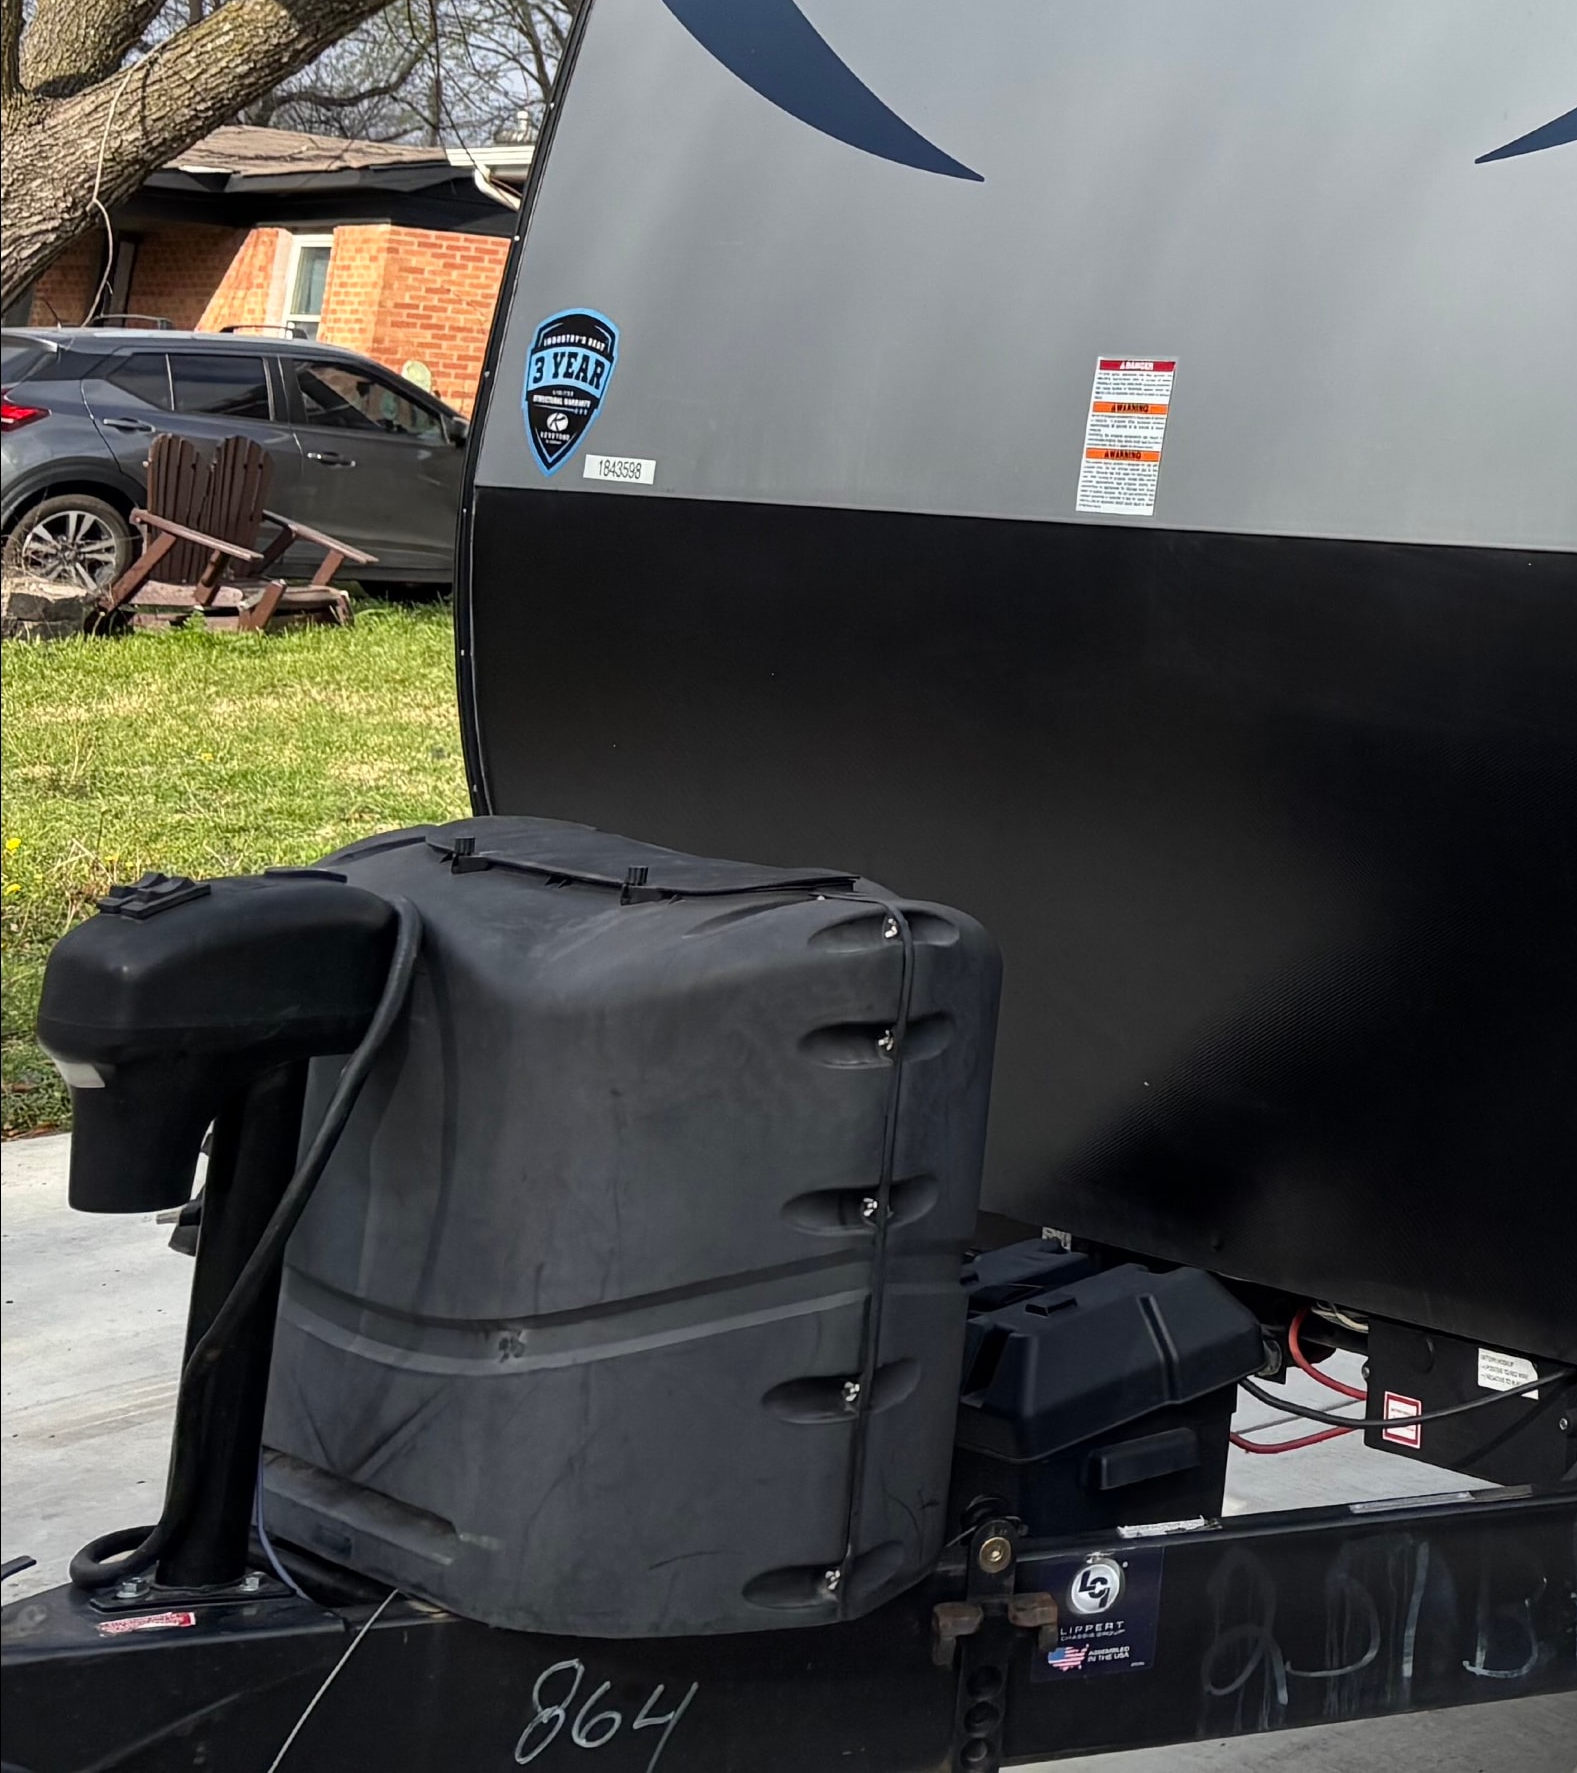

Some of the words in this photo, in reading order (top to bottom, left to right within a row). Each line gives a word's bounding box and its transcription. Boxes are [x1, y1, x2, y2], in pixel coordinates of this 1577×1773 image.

[533, 356, 545, 384] 3
[552, 351, 605, 390] YEAR
[1116, 404, 1149, 413] WARNING
[1109, 451, 1142, 460] WARNING
[1060, 1621, 1124, 1635] LIPPERT
[1088, 1646, 1130, 1656] ASSEMBLED
[1113, 1651, 1130, 1659] USA
[514, 1657, 699, 1773] 864
